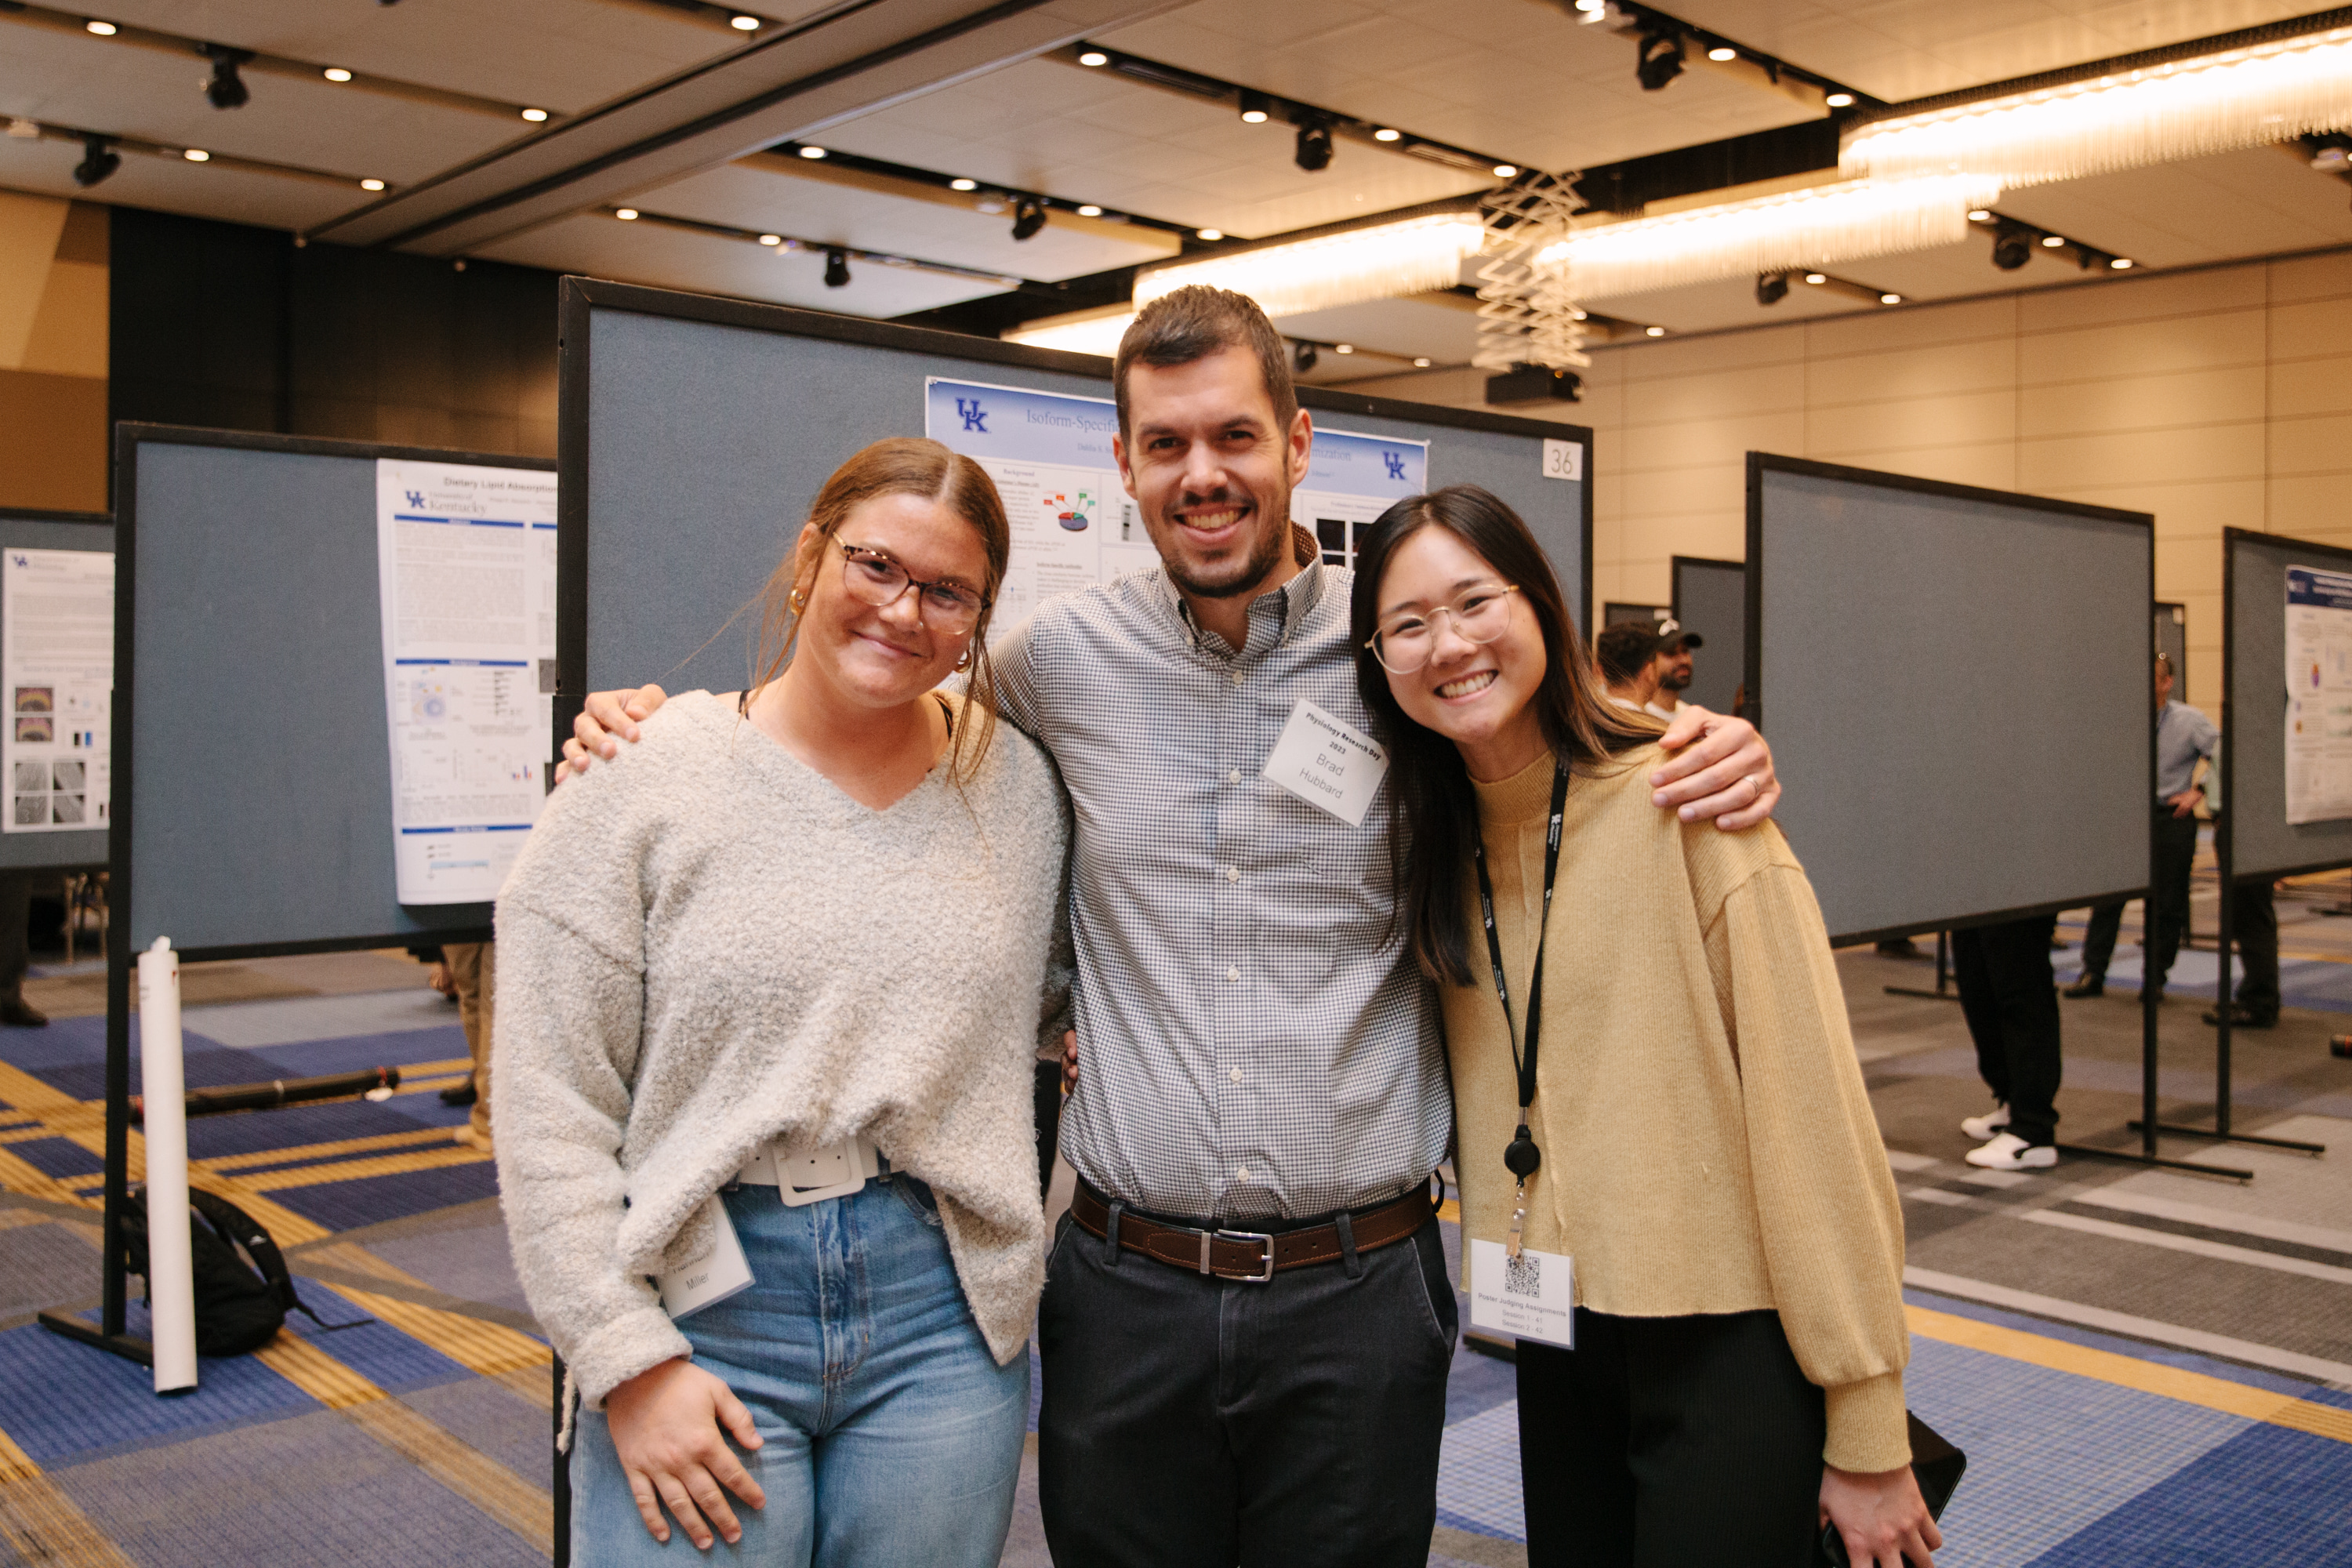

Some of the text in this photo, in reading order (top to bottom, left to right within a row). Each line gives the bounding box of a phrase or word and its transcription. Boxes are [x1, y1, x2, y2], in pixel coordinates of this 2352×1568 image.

[1552, 448, 1572, 474] 36
[443, 477, 478, 489] Dietary
[481, 480, 506, 491] Lipid
[1306, 712, 1381, 761] Physiology Research Day
[1329, 741, 1346, 754] 2023
[1316, 753, 1345, 776] Brad
[1299, 768, 1343, 799] Hubbard
[686, 1273, 709, 1290] Miller
[1478, 1292, 1566, 1316] Poster Judging Assignments
[1502, 1309, 1525, 1319] Session
[1502, 1319, 1525, 1330] Session
